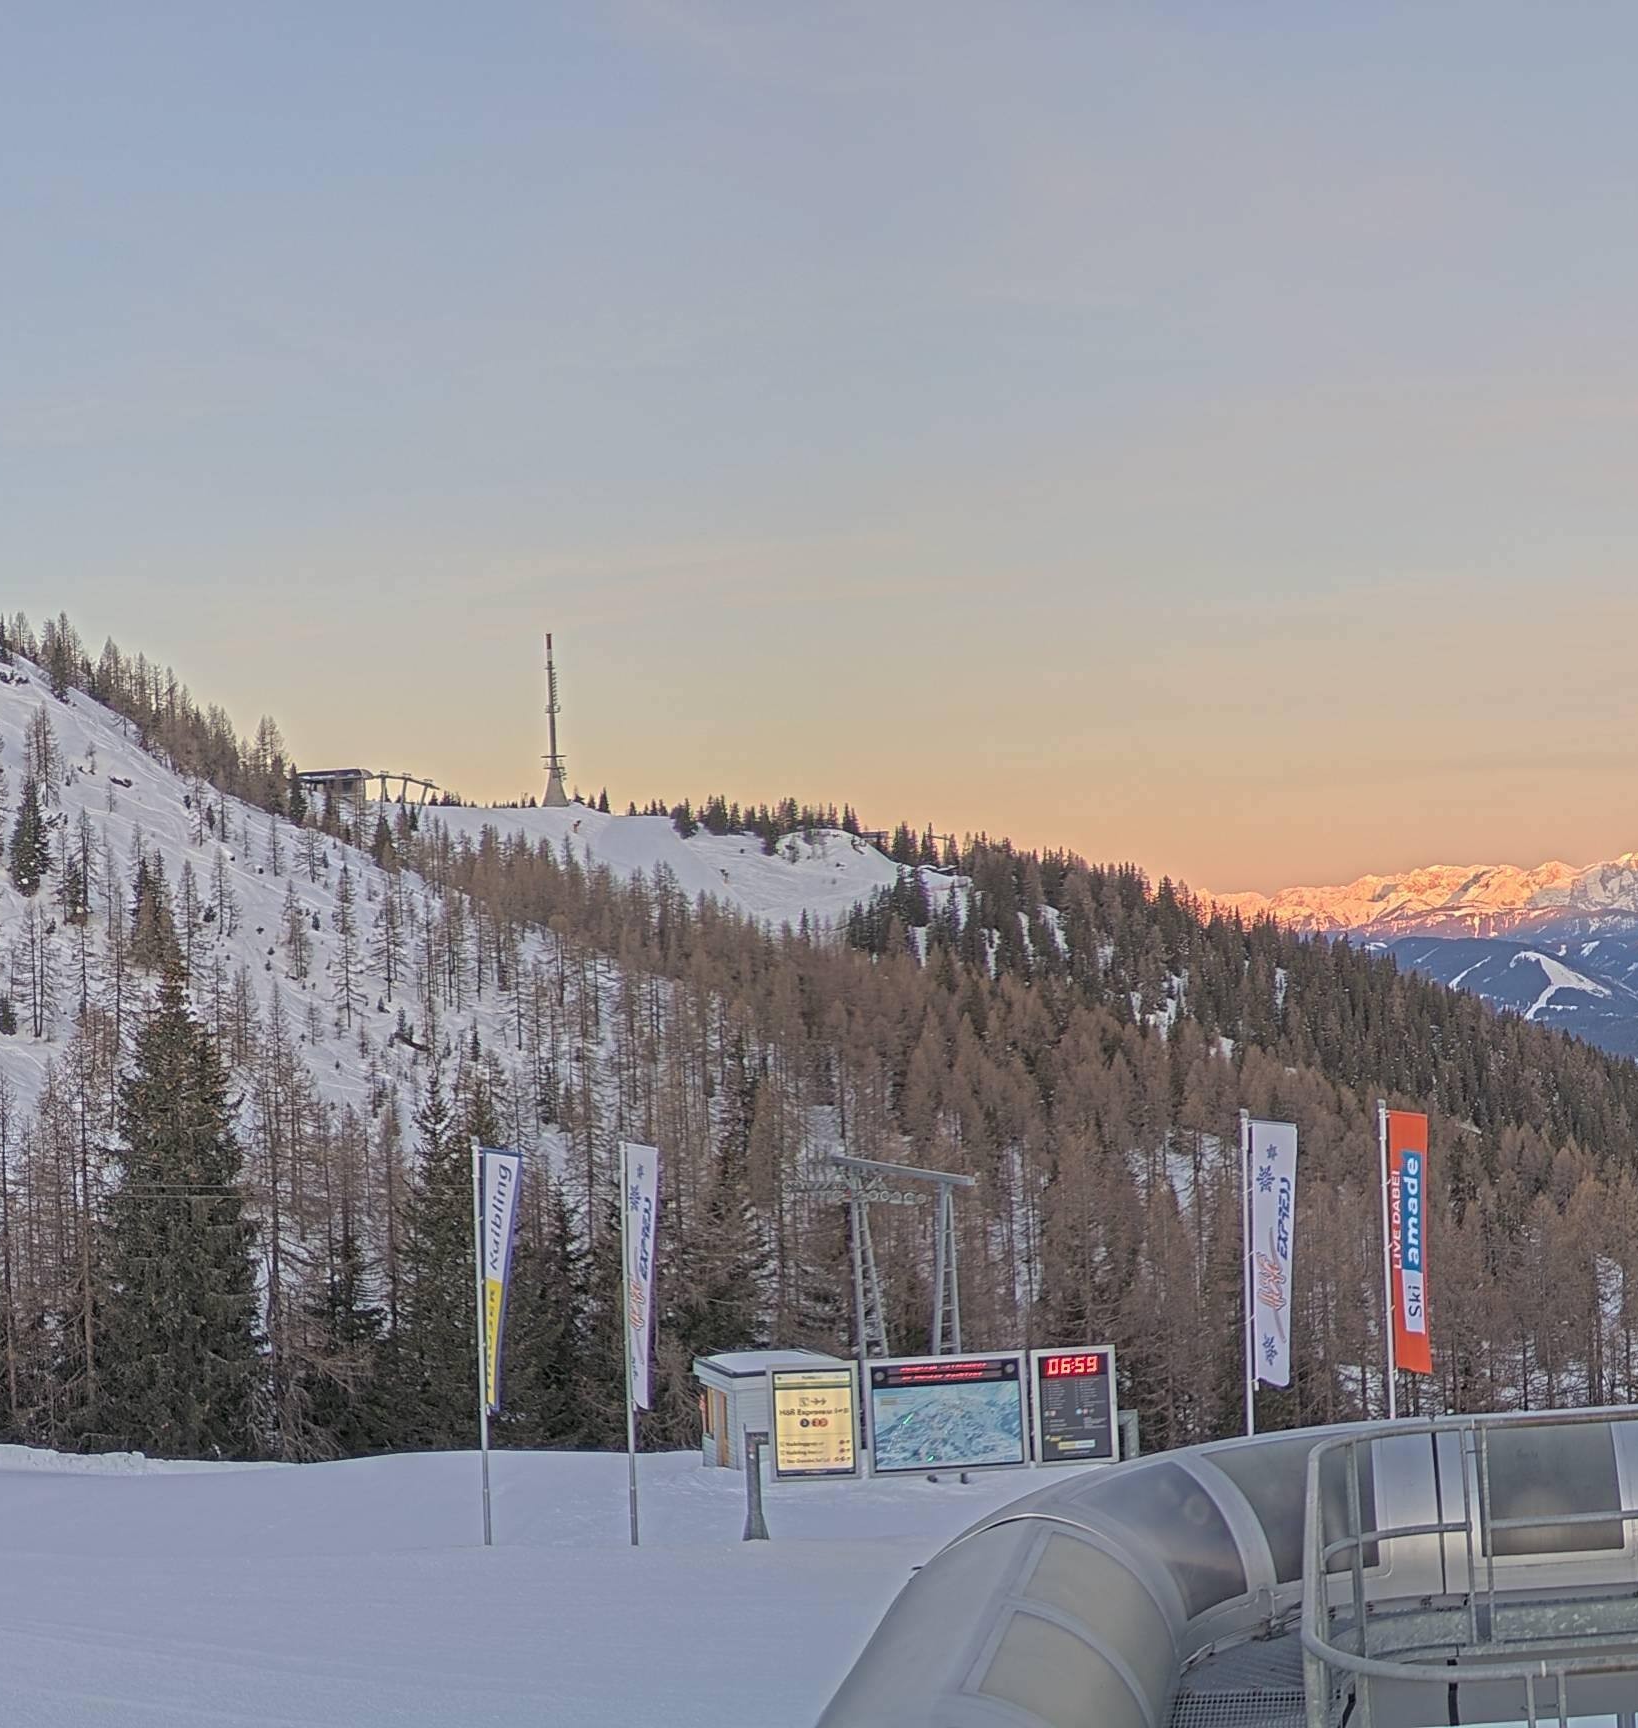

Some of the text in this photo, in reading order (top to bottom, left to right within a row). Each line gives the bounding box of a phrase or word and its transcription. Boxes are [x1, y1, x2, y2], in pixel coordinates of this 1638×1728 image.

[489, 1163, 512, 1272] Kaibling
[1391, 1170, 1402, 1269] LIVE DABEI
[1408, 1284, 1422, 1318] Ski
[1047, 1355, 1098, 1376] 06:59
